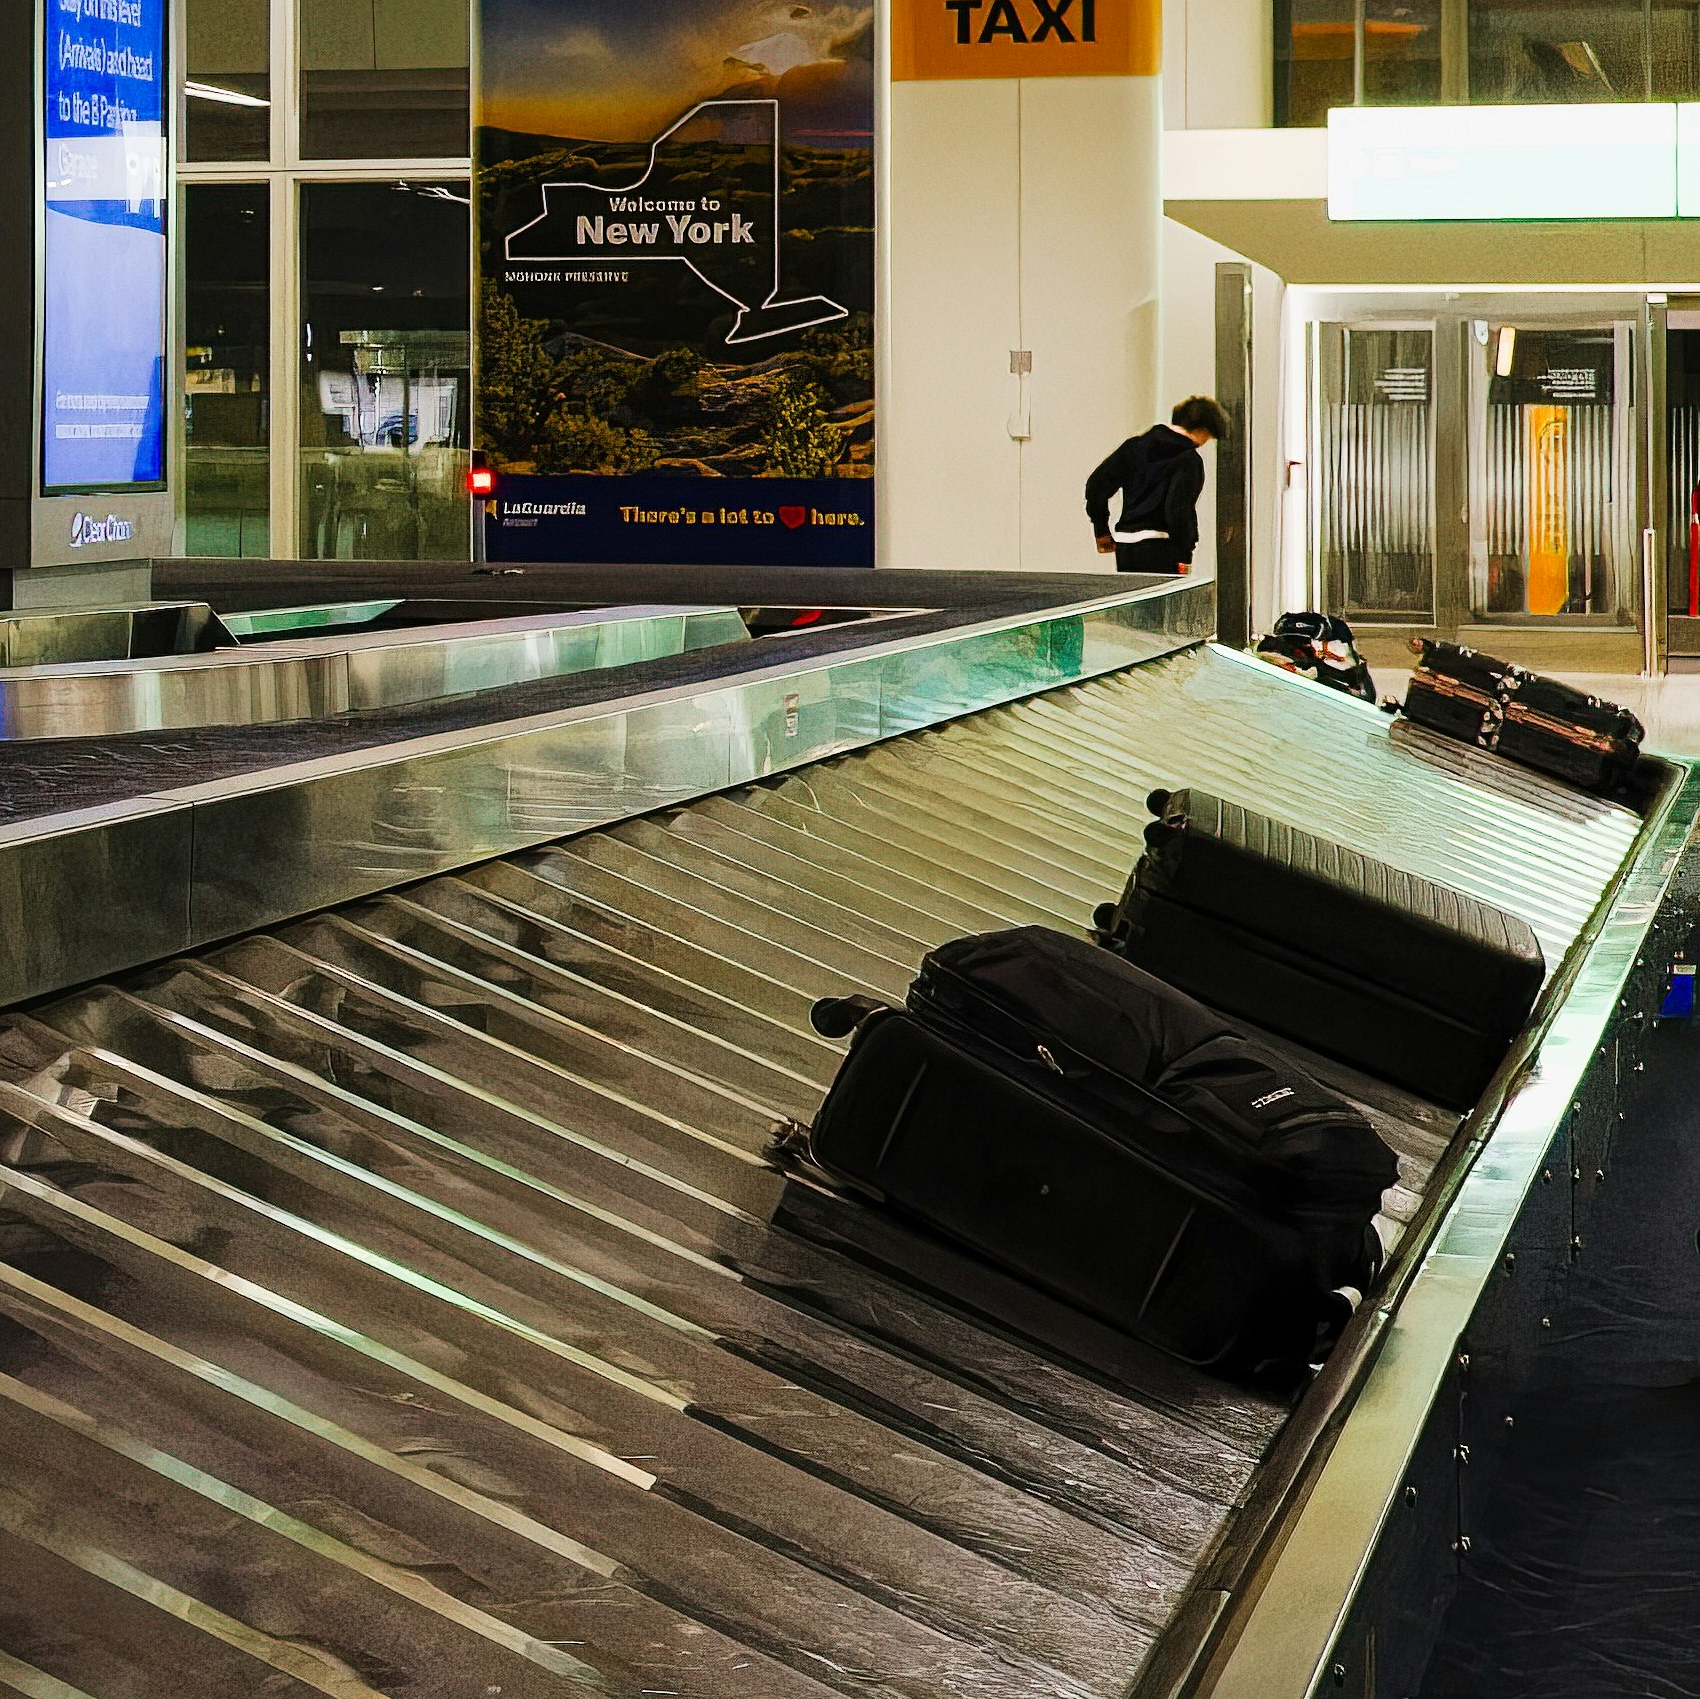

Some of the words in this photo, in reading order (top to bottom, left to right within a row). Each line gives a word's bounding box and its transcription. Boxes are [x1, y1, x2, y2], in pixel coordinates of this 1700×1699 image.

[59, 28, 106, 76] (Arrivals)
[107, 46, 127, 77] and
[127, 45, 153, 82] head
[59, 90, 71, 122] to
[72, 91, 91, 126] the
[609, 196, 696, 213] Welcome
[701, 196, 721, 212] to
[576, 214, 660, 245] New
[665, 213, 755, 245] York
[503, 501, 586, 515] LaGuardia
[619, 506, 697, 524] There's
[701, 511, 715, 524] a
[719, 507, 748, 524] lot
[752, 509, 775, 525] to
[810, 507, 865, 526] here.
